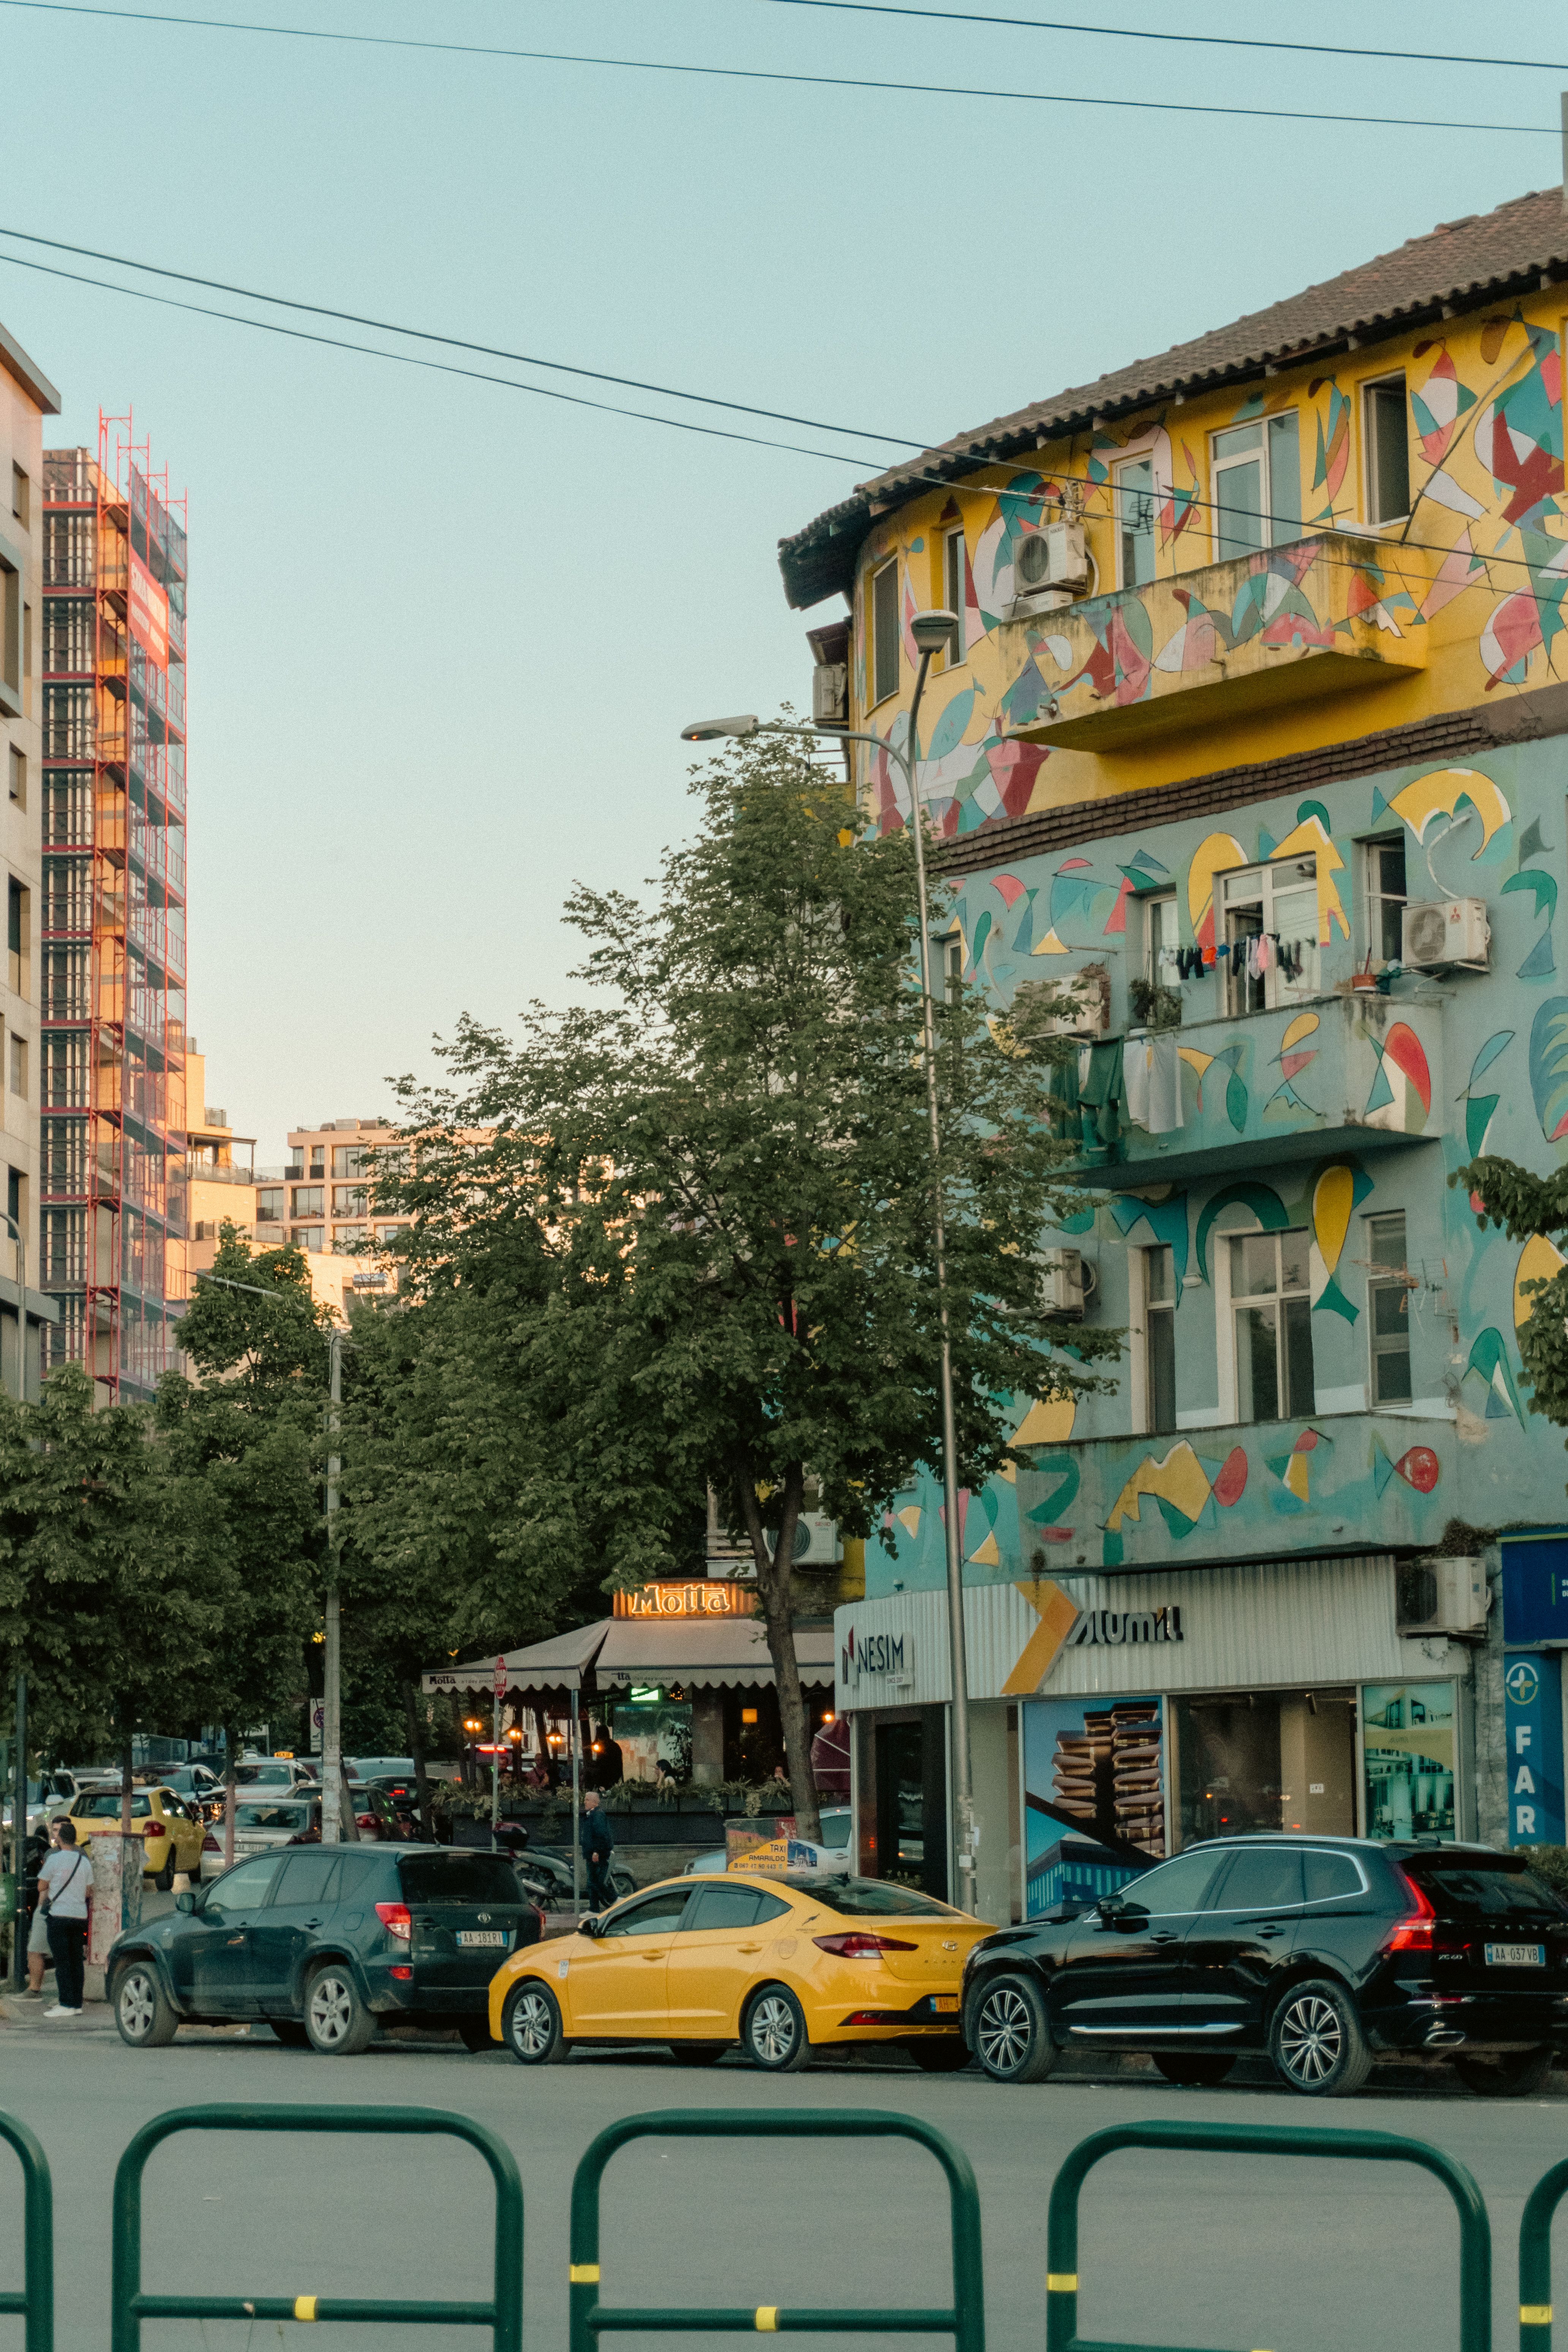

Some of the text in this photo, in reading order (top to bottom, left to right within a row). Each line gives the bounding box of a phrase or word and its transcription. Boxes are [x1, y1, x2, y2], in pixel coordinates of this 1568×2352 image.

[632, 1584, 730, 1614] Motta
[1066, 1606, 1184, 1645] Alumil
[857, 1633, 903, 1673] NESIM
[429, 1675, 456, 1685] Motta
[611, 1672, 631, 1680] tta
[1514, 1726, 1538, 1854] FAR
[770, 1844, 786, 1853] TAXI
[464, 1933, 474, 1943] AA
[1495, 1948, 1506, 1960] AA
[939, 1998, 949, 2010] AH
